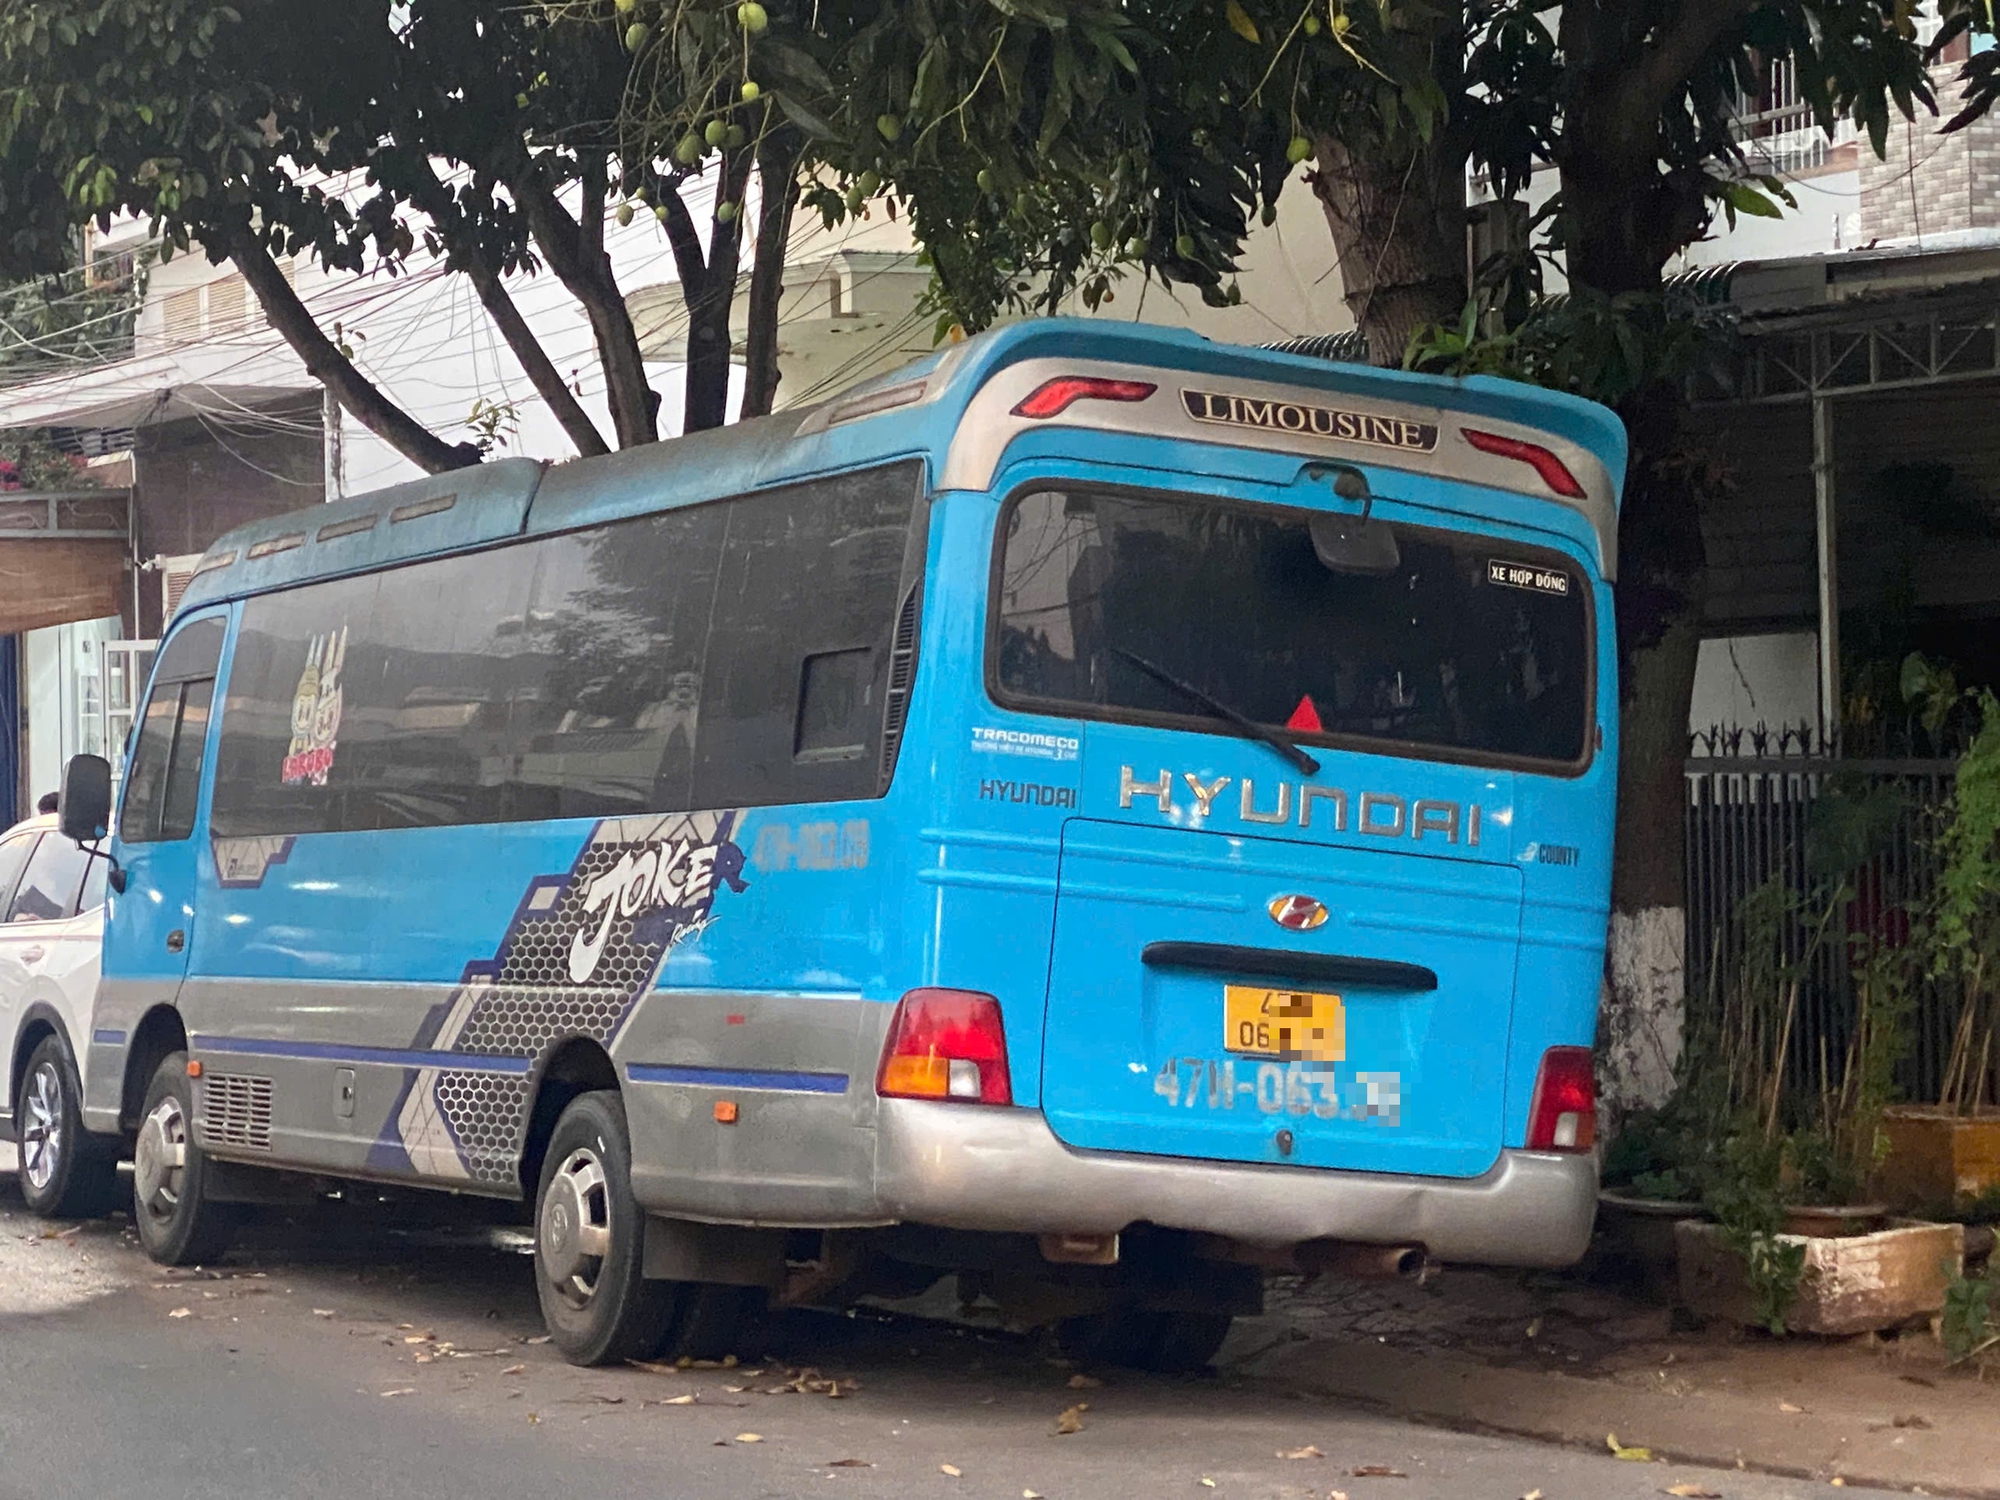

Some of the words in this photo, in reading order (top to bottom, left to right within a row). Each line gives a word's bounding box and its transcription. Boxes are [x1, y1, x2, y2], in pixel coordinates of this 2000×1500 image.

[1204, 394, 1424, 448] LIMOUSINE
[1491, 566, 1506, 580] XE
[972, 727, 1079, 750] TRACOMECO
[980, 779, 1076, 809] HYUNDAI
[1119, 765, 1480, 846] HYUNDAI
[1539, 843, 1579, 867] COUNTY
[569, 838, 750, 984] JOKER
